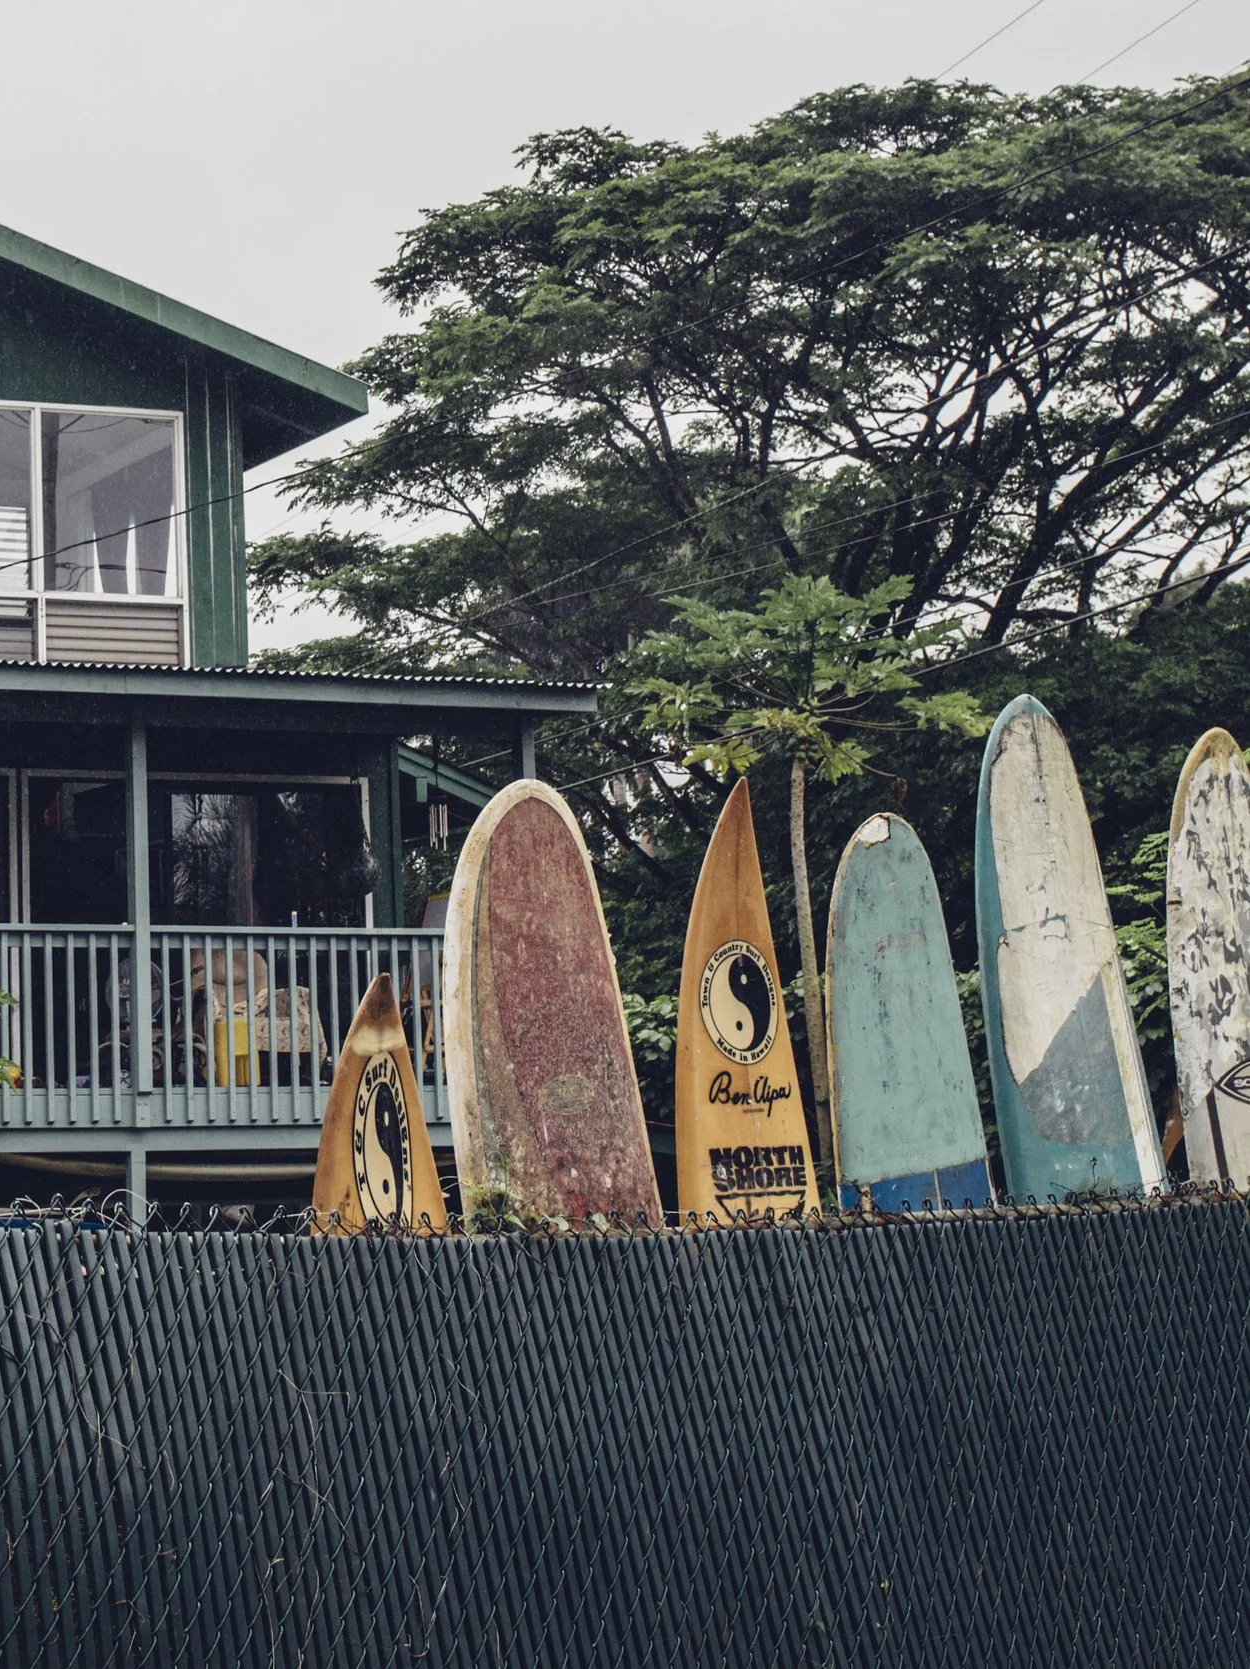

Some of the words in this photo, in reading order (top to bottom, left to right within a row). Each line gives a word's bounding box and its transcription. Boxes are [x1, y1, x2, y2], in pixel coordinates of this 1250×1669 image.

[702, 977, 710, 1008] Town
[714, 943, 743, 962] Country
[745, 945, 761, 962] Surf
[716, 1038, 737, 1058] Made
[740, 1053, 748, 1061] in
[751, 1035, 772, 1060] Hawaii
[358, 1094, 365, 1117] C
[365, 1058, 388, 1093] Surf
[709, 1071, 751, 1105] Ben
[709, 1146, 805, 1168] NORTH
[711, 1166, 808, 1192] SHORE
